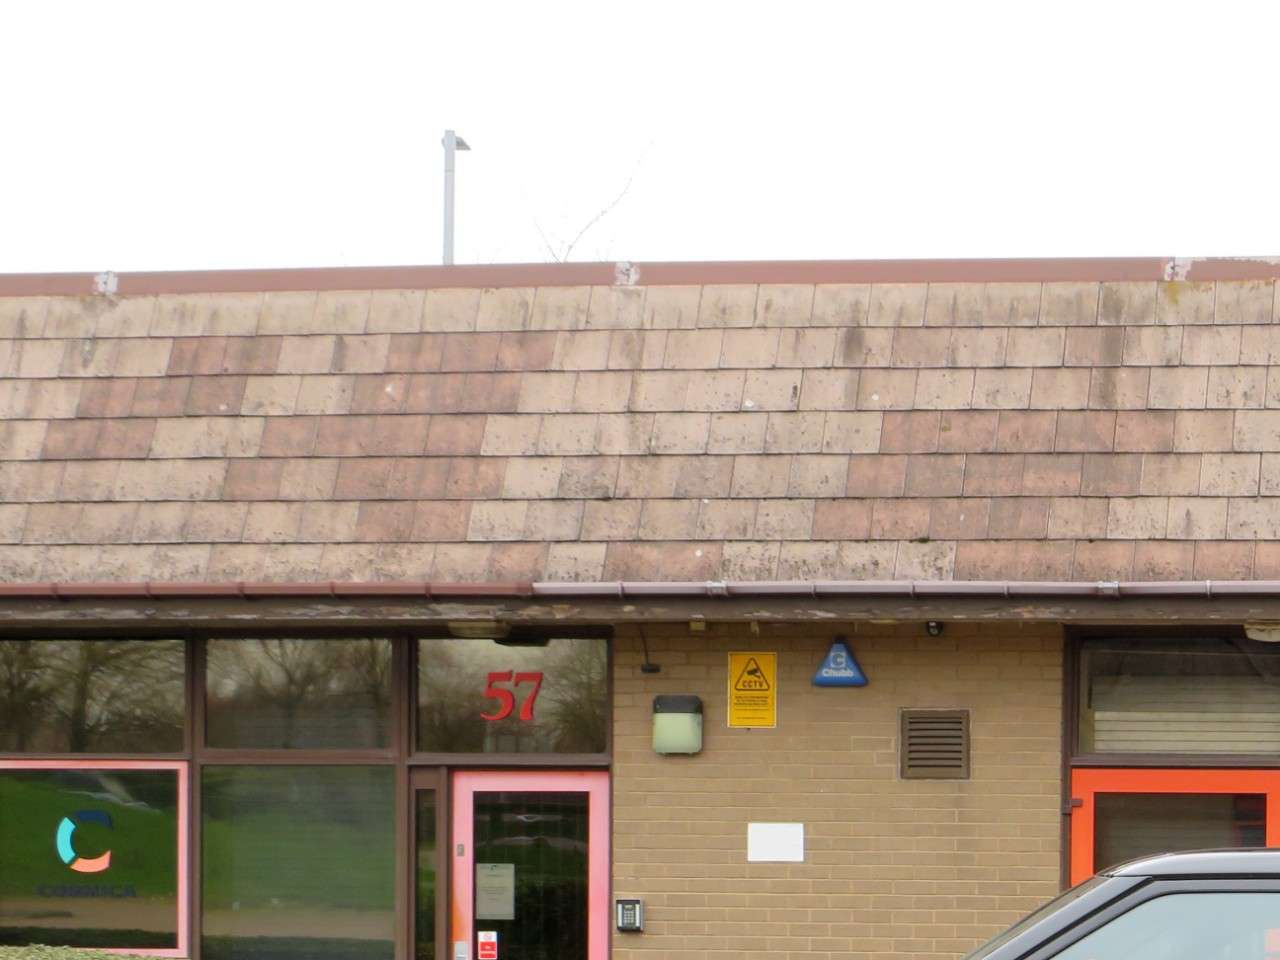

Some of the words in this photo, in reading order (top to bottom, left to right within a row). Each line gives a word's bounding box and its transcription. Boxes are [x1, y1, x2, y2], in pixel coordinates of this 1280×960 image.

[821, 668, 854, 678] Chubb
[742, 680, 764, 688] CCTV
[480, 670, 543, 721] 57
